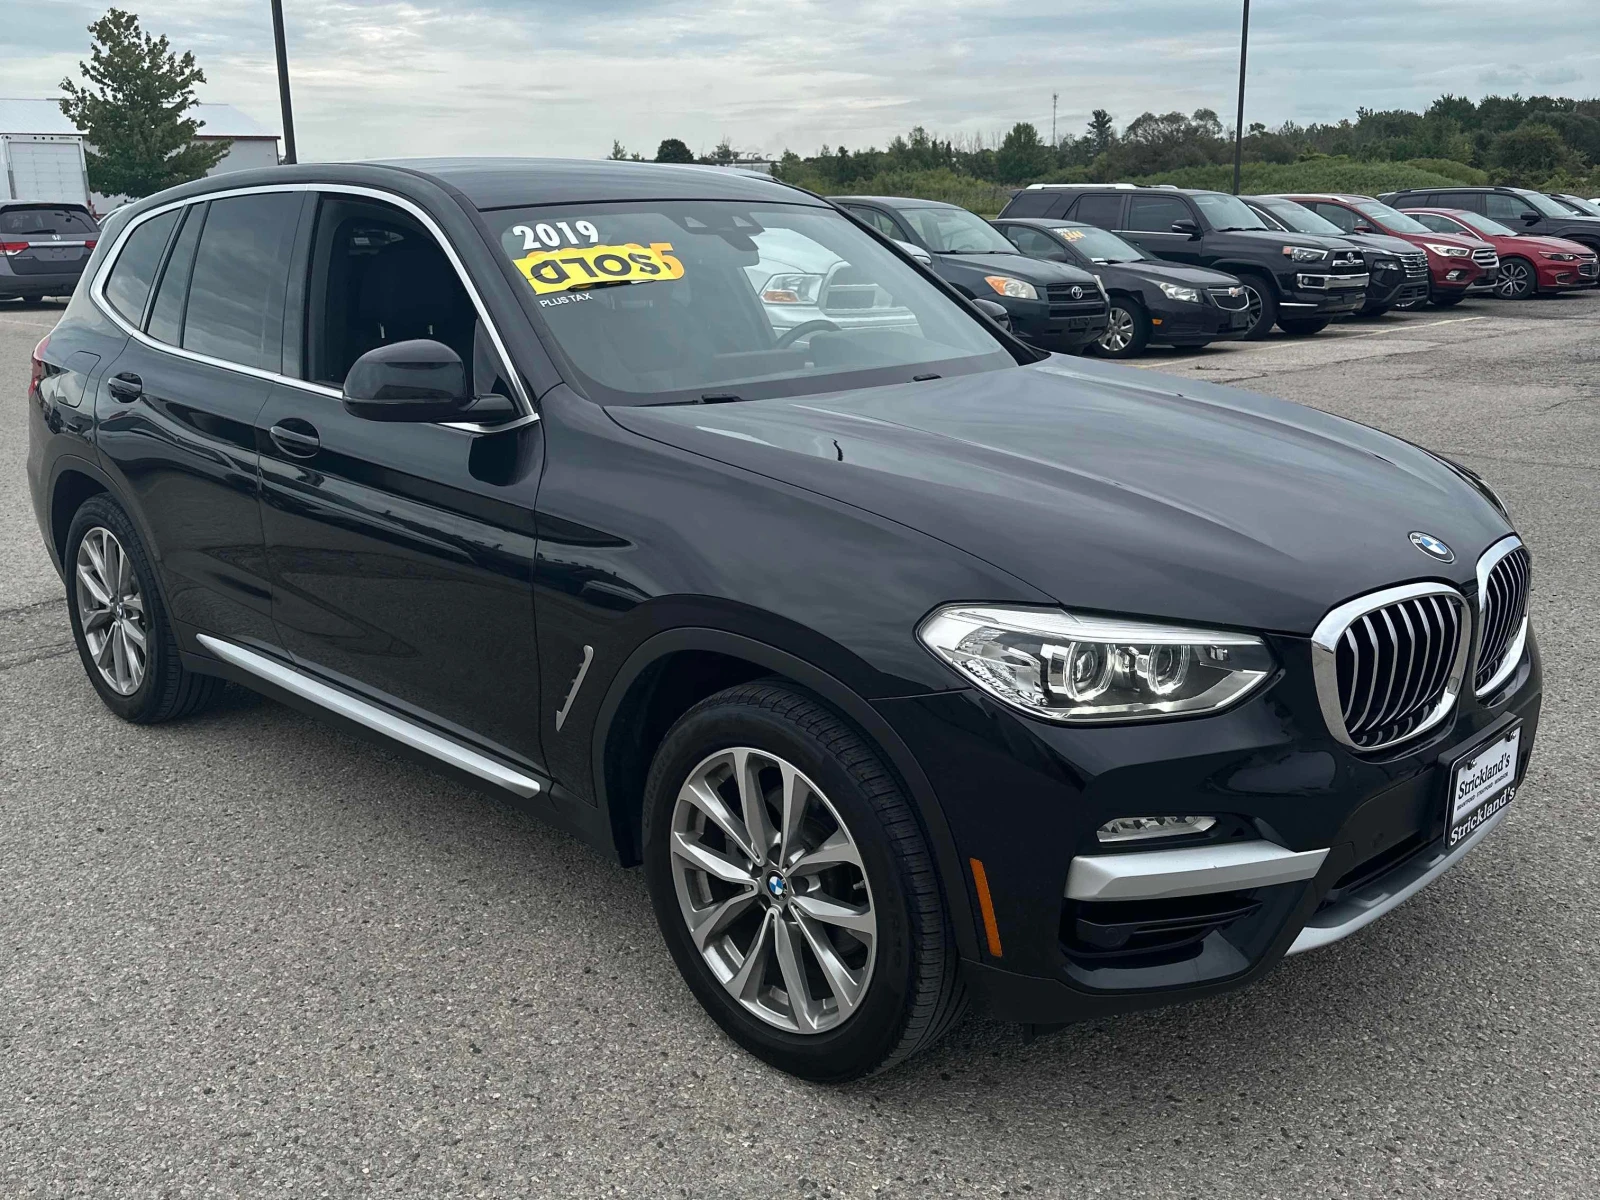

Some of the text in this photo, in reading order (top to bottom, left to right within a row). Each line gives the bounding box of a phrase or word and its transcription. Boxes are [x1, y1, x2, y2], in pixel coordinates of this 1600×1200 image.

[512, 220, 599, 250] 2019
[530, 253, 661, 284] SOLD
[539, 292, 593, 308] PLUS TAX
[1458, 752, 1511, 800] Strickland's
[1450, 786, 1515, 846] Strickland's
